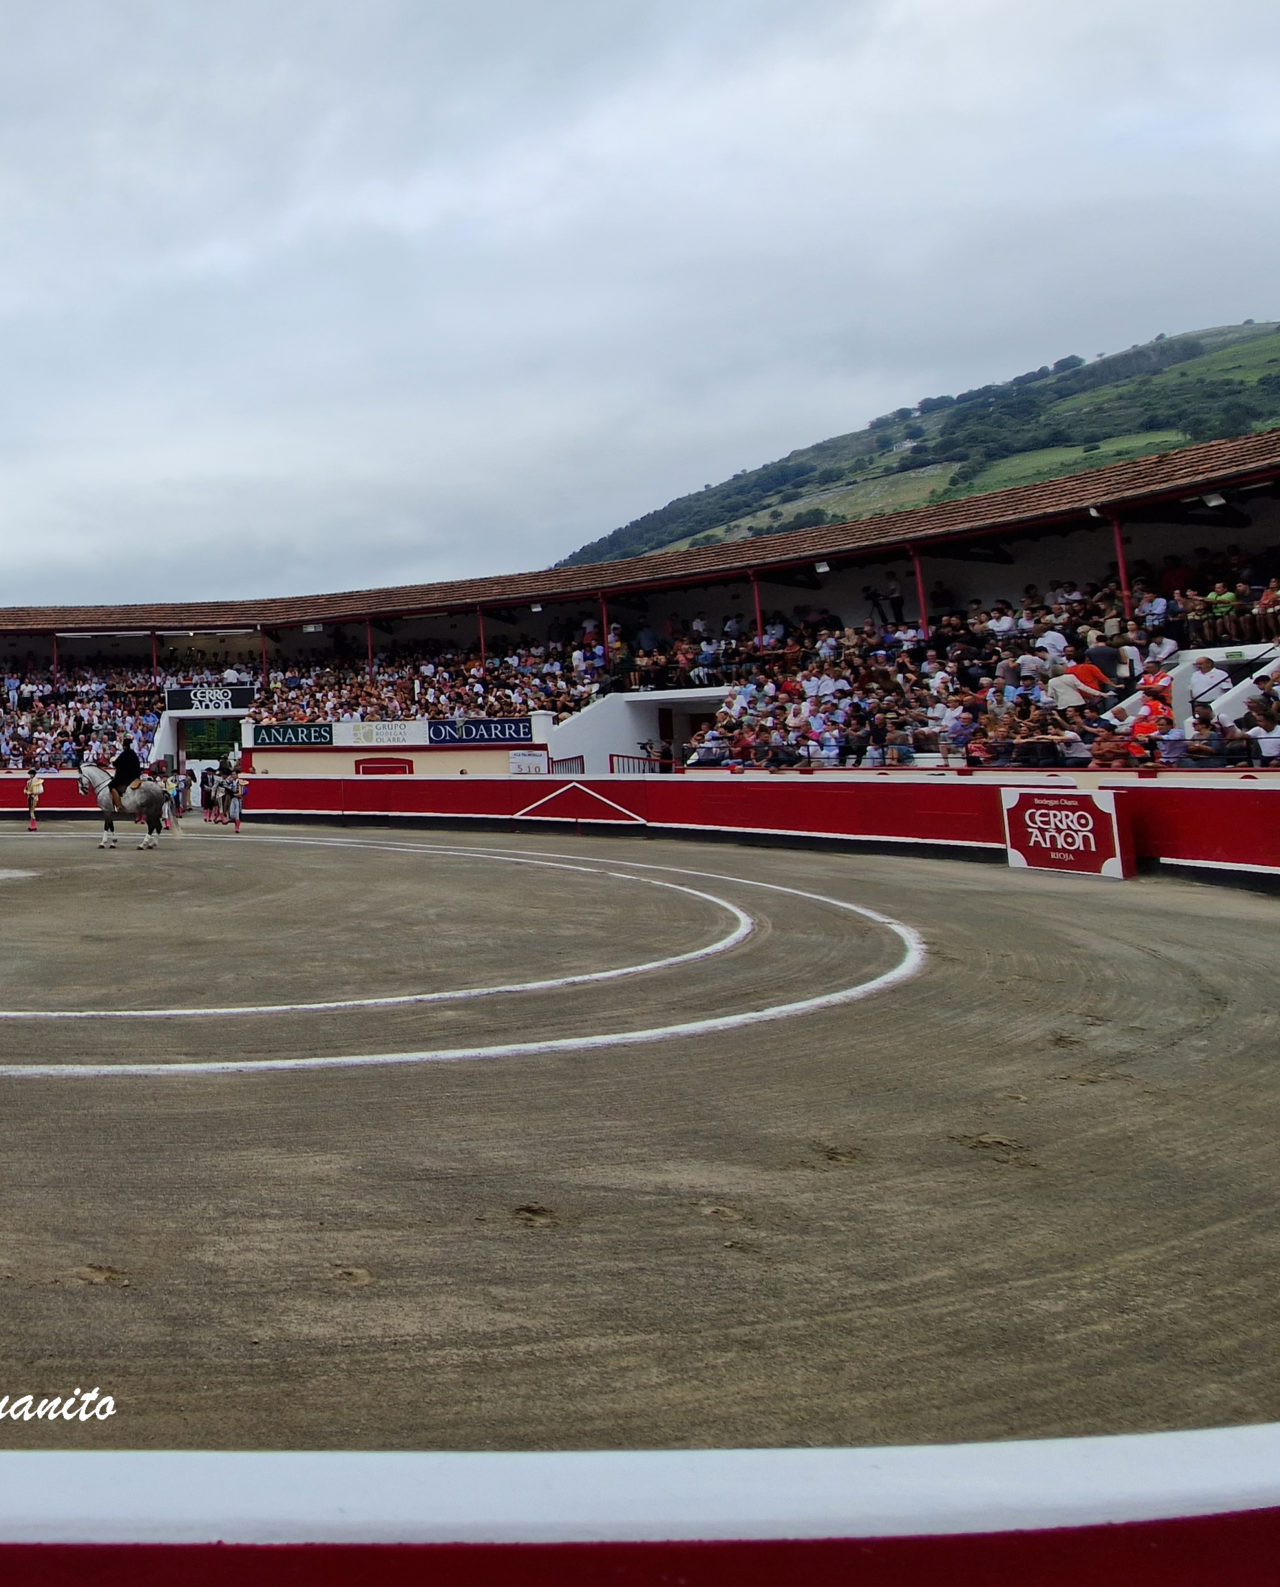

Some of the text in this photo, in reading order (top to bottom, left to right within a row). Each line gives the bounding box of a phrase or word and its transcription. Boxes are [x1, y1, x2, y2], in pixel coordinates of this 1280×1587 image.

[190, 689, 232, 701] CERRO
[375, 723, 407, 731] GRUPO
[429, 723, 531, 741] ONDARRE
[257, 726, 330, 743] AÑARES
[1024, 809, 1094, 831] CERRO
[1050, 851, 1075, 861] RIOJA
